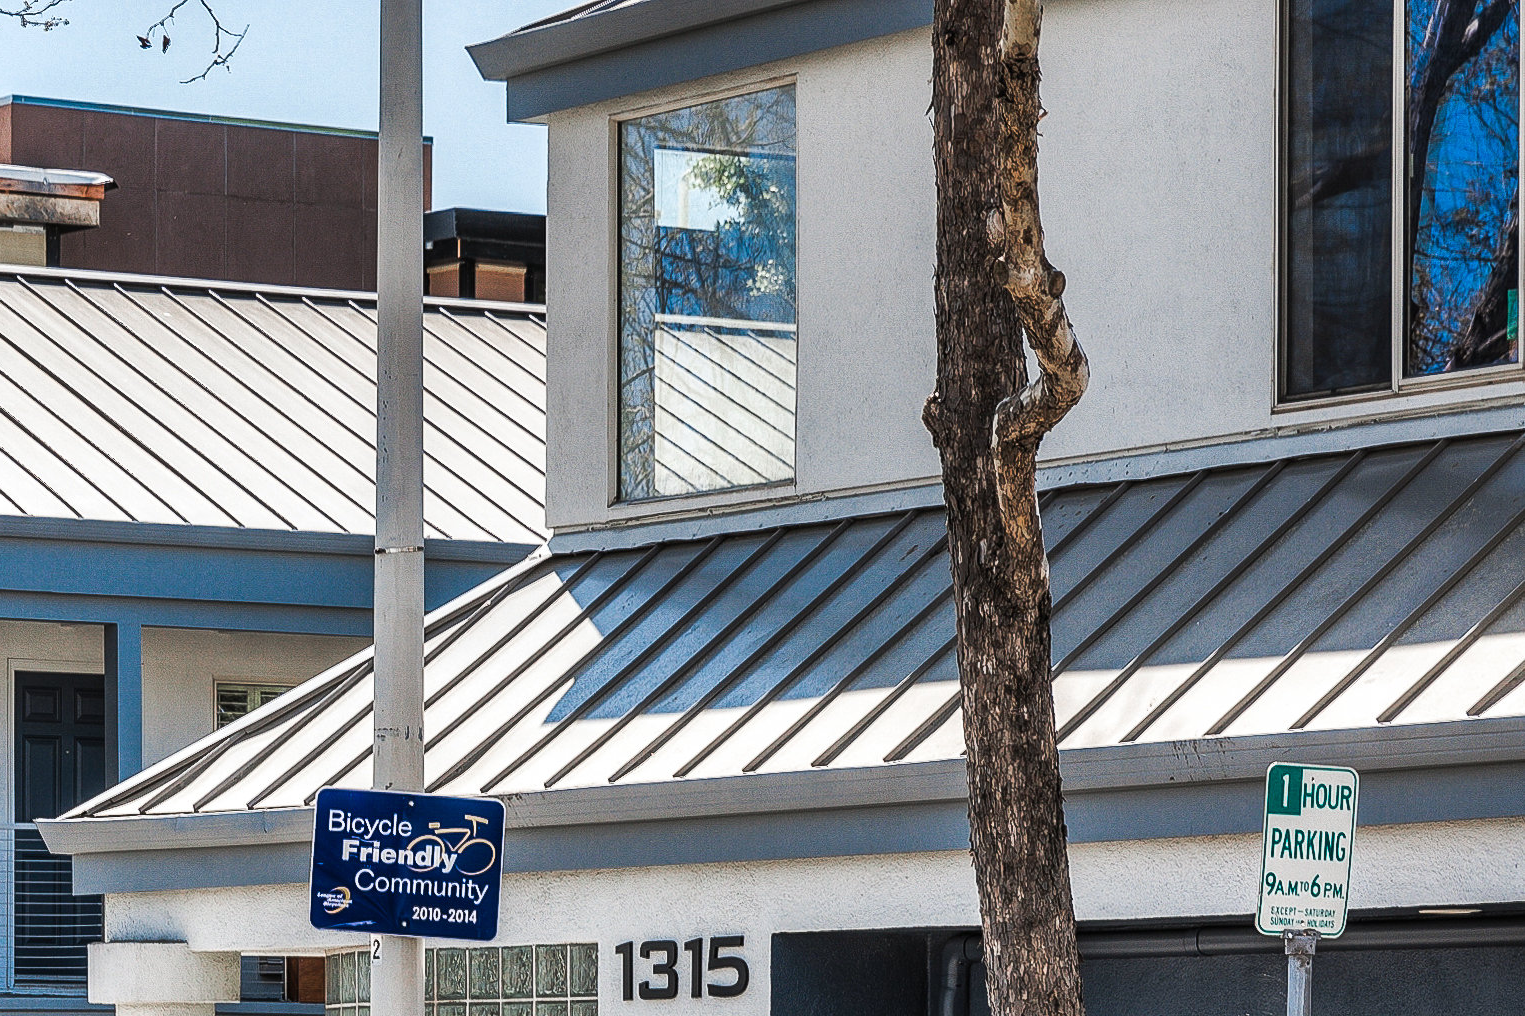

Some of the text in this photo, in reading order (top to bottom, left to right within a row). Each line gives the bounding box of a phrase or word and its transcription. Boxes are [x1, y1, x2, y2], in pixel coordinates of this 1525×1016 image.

[1282, 774, 1352, 811] 1 HOUR
[328, 809, 413, 840] Bicycle
[341, 839, 458, 874] Friendly
[1270, 827, 1346, 862] PARKING
[354, 868, 489, 905] Community
[412, 906, 477, 924] 2010-2014
[1270, 906, 1336, 918] EXCEPT SATURDAY
[1270, 916, 1295, 926] SUNDAY
[1307, 919, 1335, 929] HOLIDAYS
[372, 938, 381, 960] 2
[615, 935, 750, 1002] 1315
